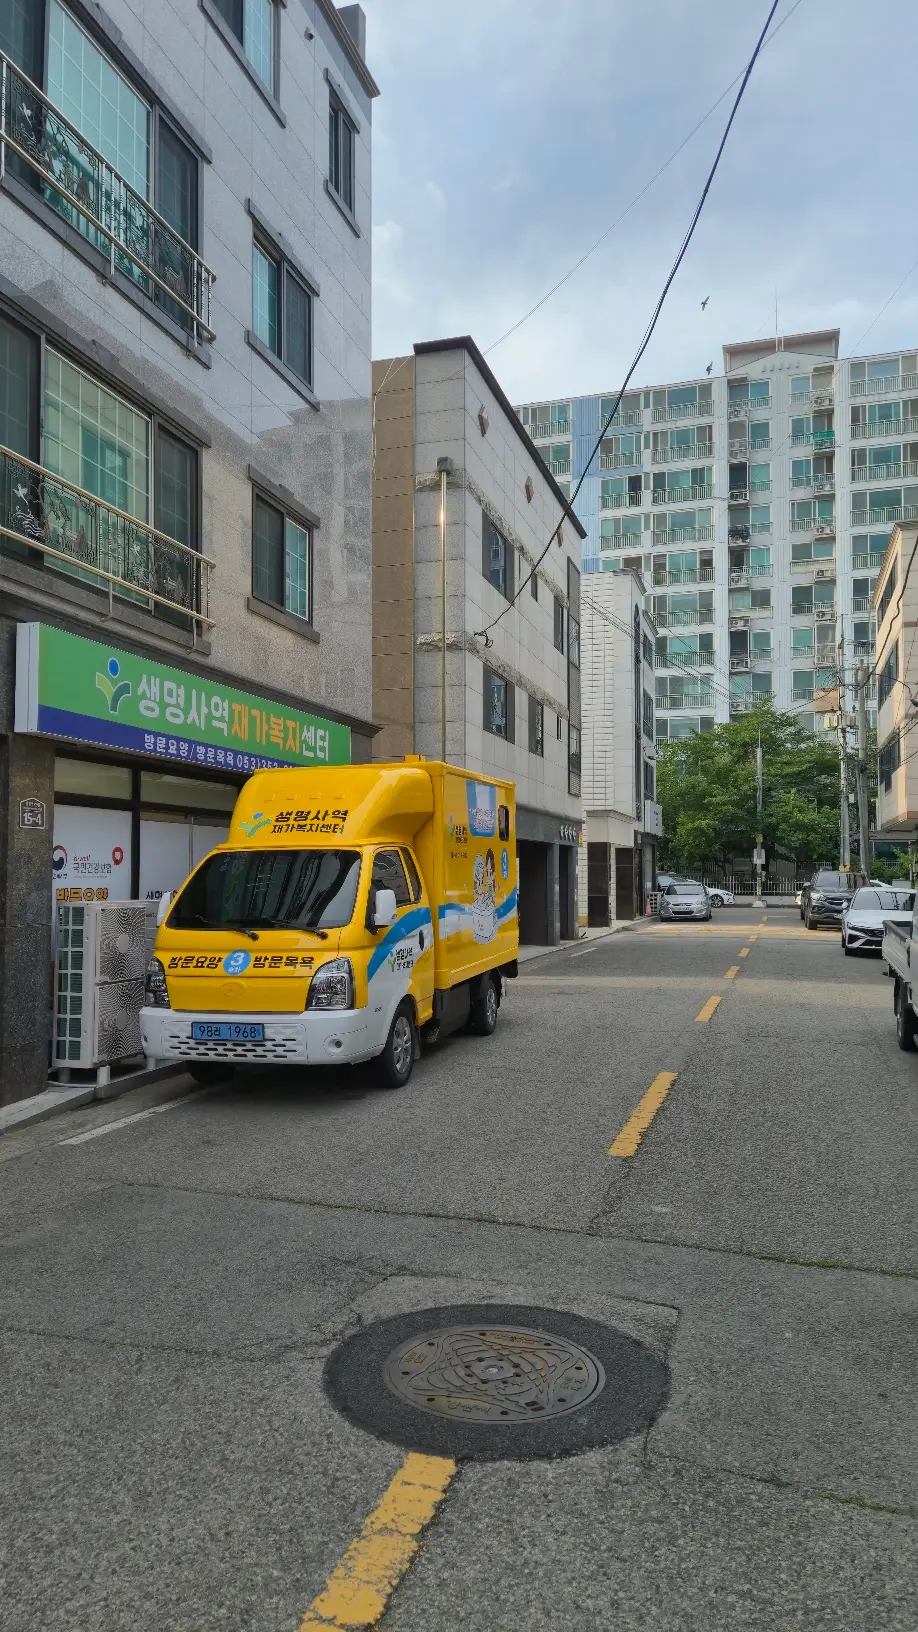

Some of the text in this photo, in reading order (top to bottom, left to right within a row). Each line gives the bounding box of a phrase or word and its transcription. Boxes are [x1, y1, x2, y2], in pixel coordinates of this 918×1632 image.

[23, 812, 42, 825] 15-4
[275, 809, 348, 822] 생명사역
[271, 823, 344, 834] 재가복지센터
[73, 862, 112, 874] 국민건강보험
[167, 955, 223, 969] 방문요양
[230, 952, 244, 966] 3
[252, 955, 315, 970] 방문목욕
[228, 1025, 257, 1038] 1968
